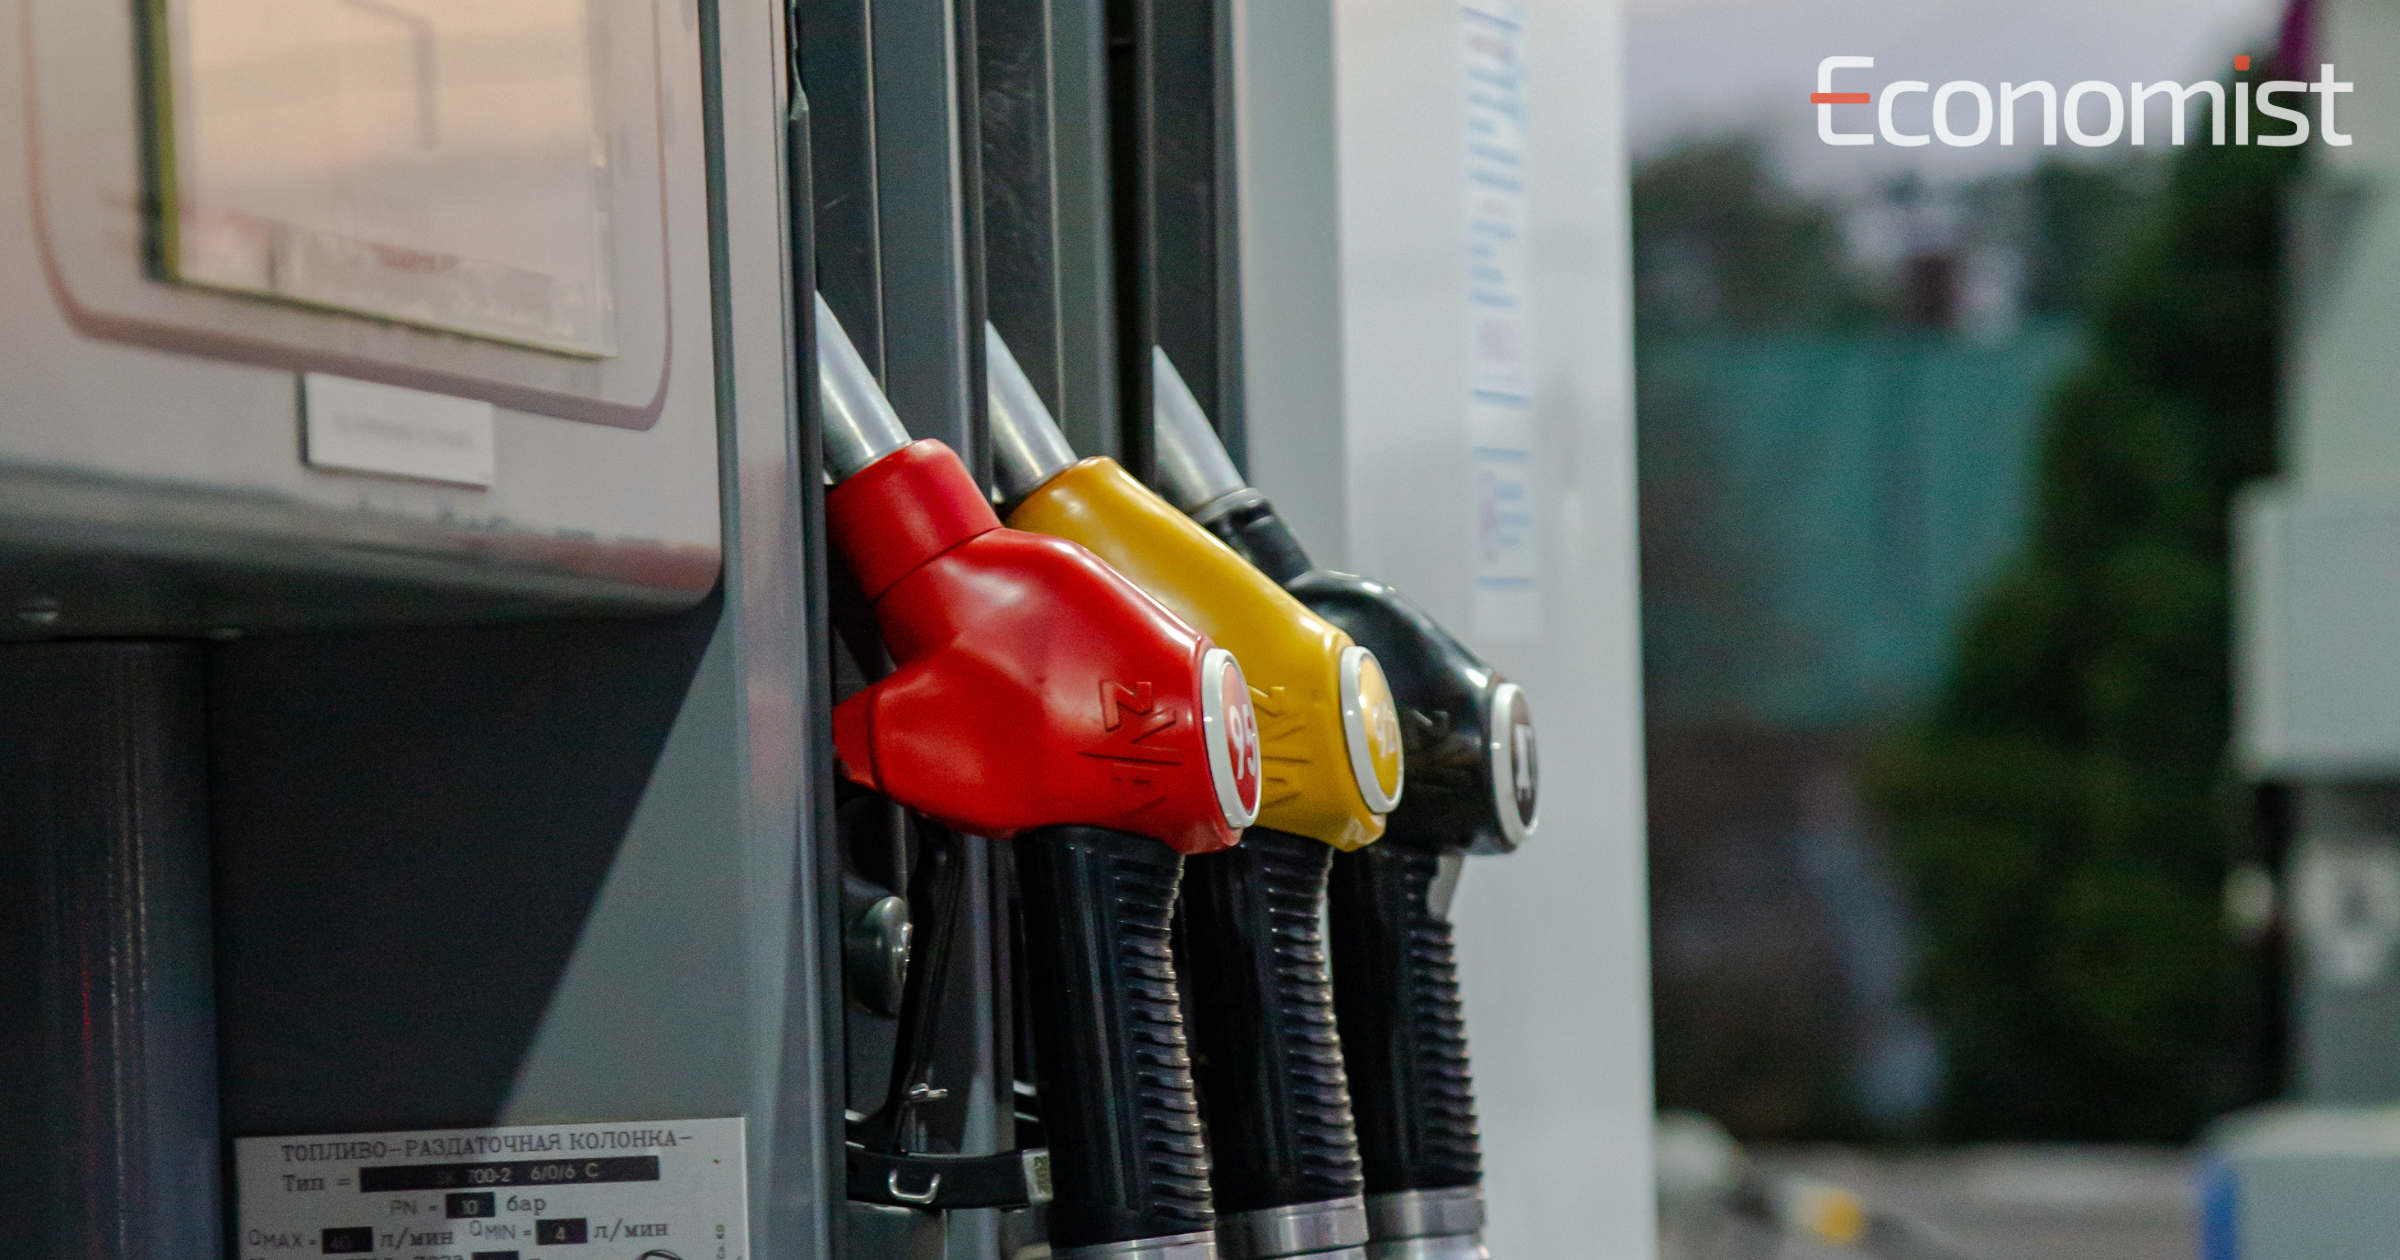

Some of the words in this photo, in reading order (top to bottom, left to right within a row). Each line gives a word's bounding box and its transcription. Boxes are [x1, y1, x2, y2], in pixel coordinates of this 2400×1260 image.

[1229, 703, 1258, 780] 95
[280, 1132, 562, 1163] ТОПЛИВО-РАЗДАТОЧНАЯ
[282, 1173, 325, 1192] Тип
[466, 1166, 513, 1185] 700-2
[529, 1163, 577, 1182] 6/0/6
[461, 1199, 479, 1216] 10
[505, 1194, 547, 1216] бар
[378, 1226, 455, 1251] л/мин
[554, 1226, 567, 1241] 4
[593, 1217, 669, 1243] л/мин
